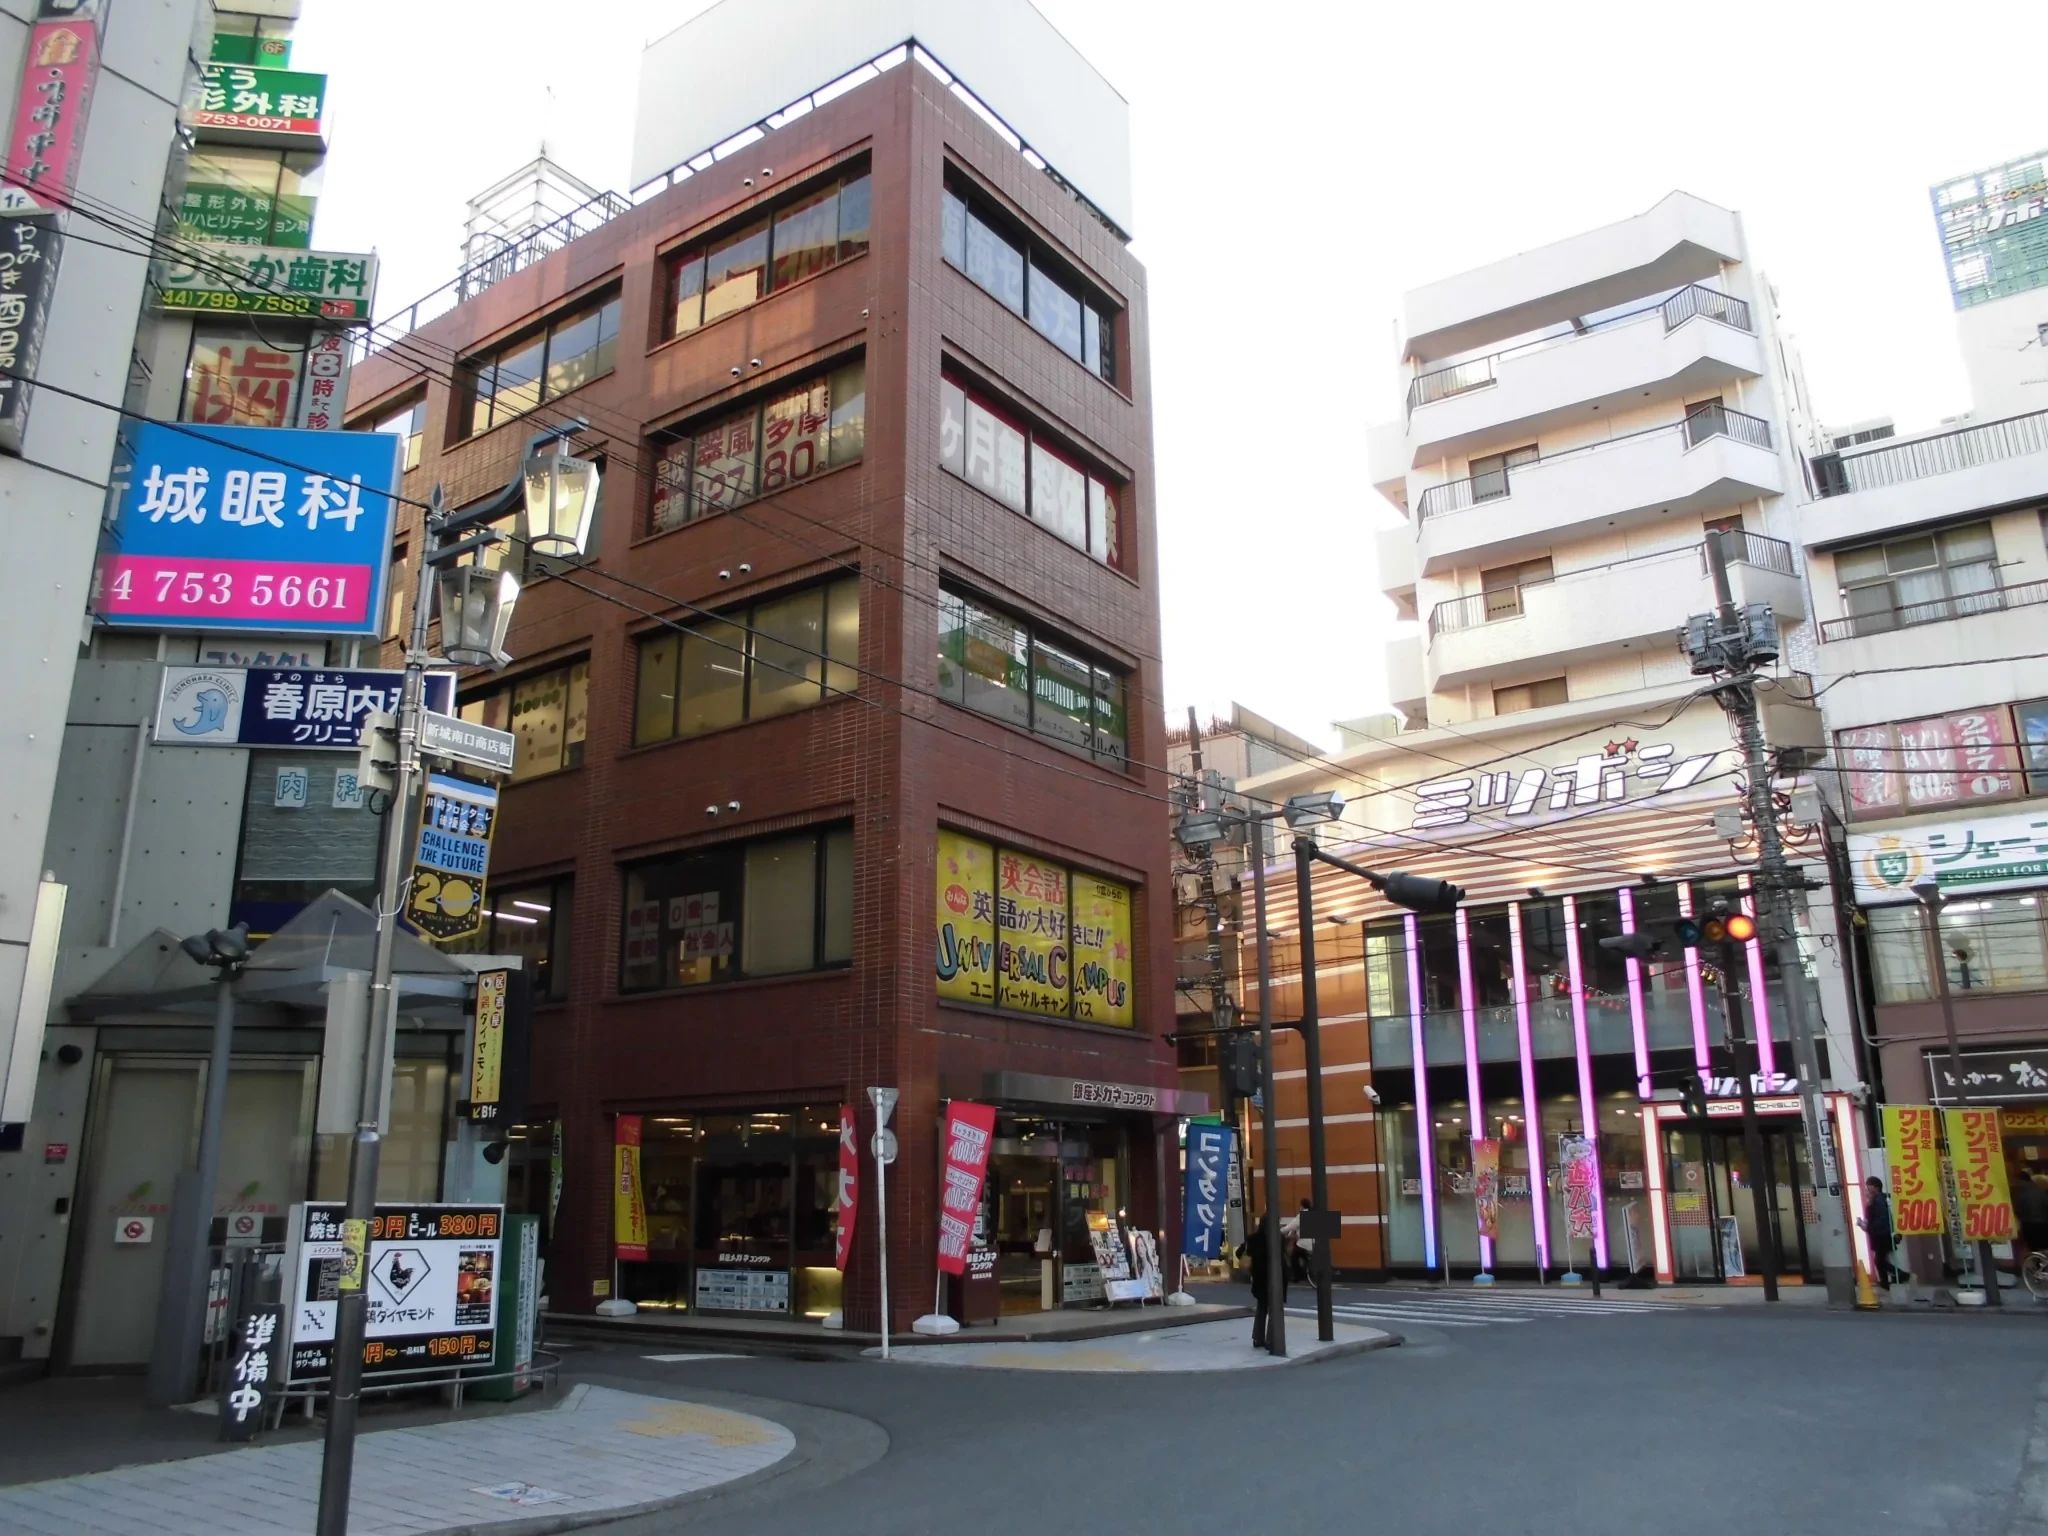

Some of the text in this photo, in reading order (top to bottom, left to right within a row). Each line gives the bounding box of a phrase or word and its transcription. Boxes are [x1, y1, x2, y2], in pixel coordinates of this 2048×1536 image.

[4, 192, 26, 208] 1F
[185, 193, 271, 211] 整形外科
[183, 212, 310, 233] リハビリテーション科
[153, 571, 233, 603] 753
[249, 574, 347, 609] 5661
[272, 672, 345, 684] すのはら
[425, 722, 512, 757] 新城南口商店街
[422, 831, 486, 858] CHALLENGE
[420, 846, 484, 873] THE FUTURE
[1000, 854, 1065, 906] 英会話
[1947, 863, 2042, 884] ENGLISH FOR
[414, 872, 474, 917] 20
[937, 922, 1127, 1008] UNIVERSAL CAMPUS
[481, 1104, 498, 1119] B1F
[1897, 1109, 1925, 1197] ワンコイン
[1961, 1112, 1995, 1201] ワンコイン
[408, 1221, 438, 1238] ビール
[440, 1213, 498, 1236] 380円
[229, 1313, 278, 1423] 準備中
